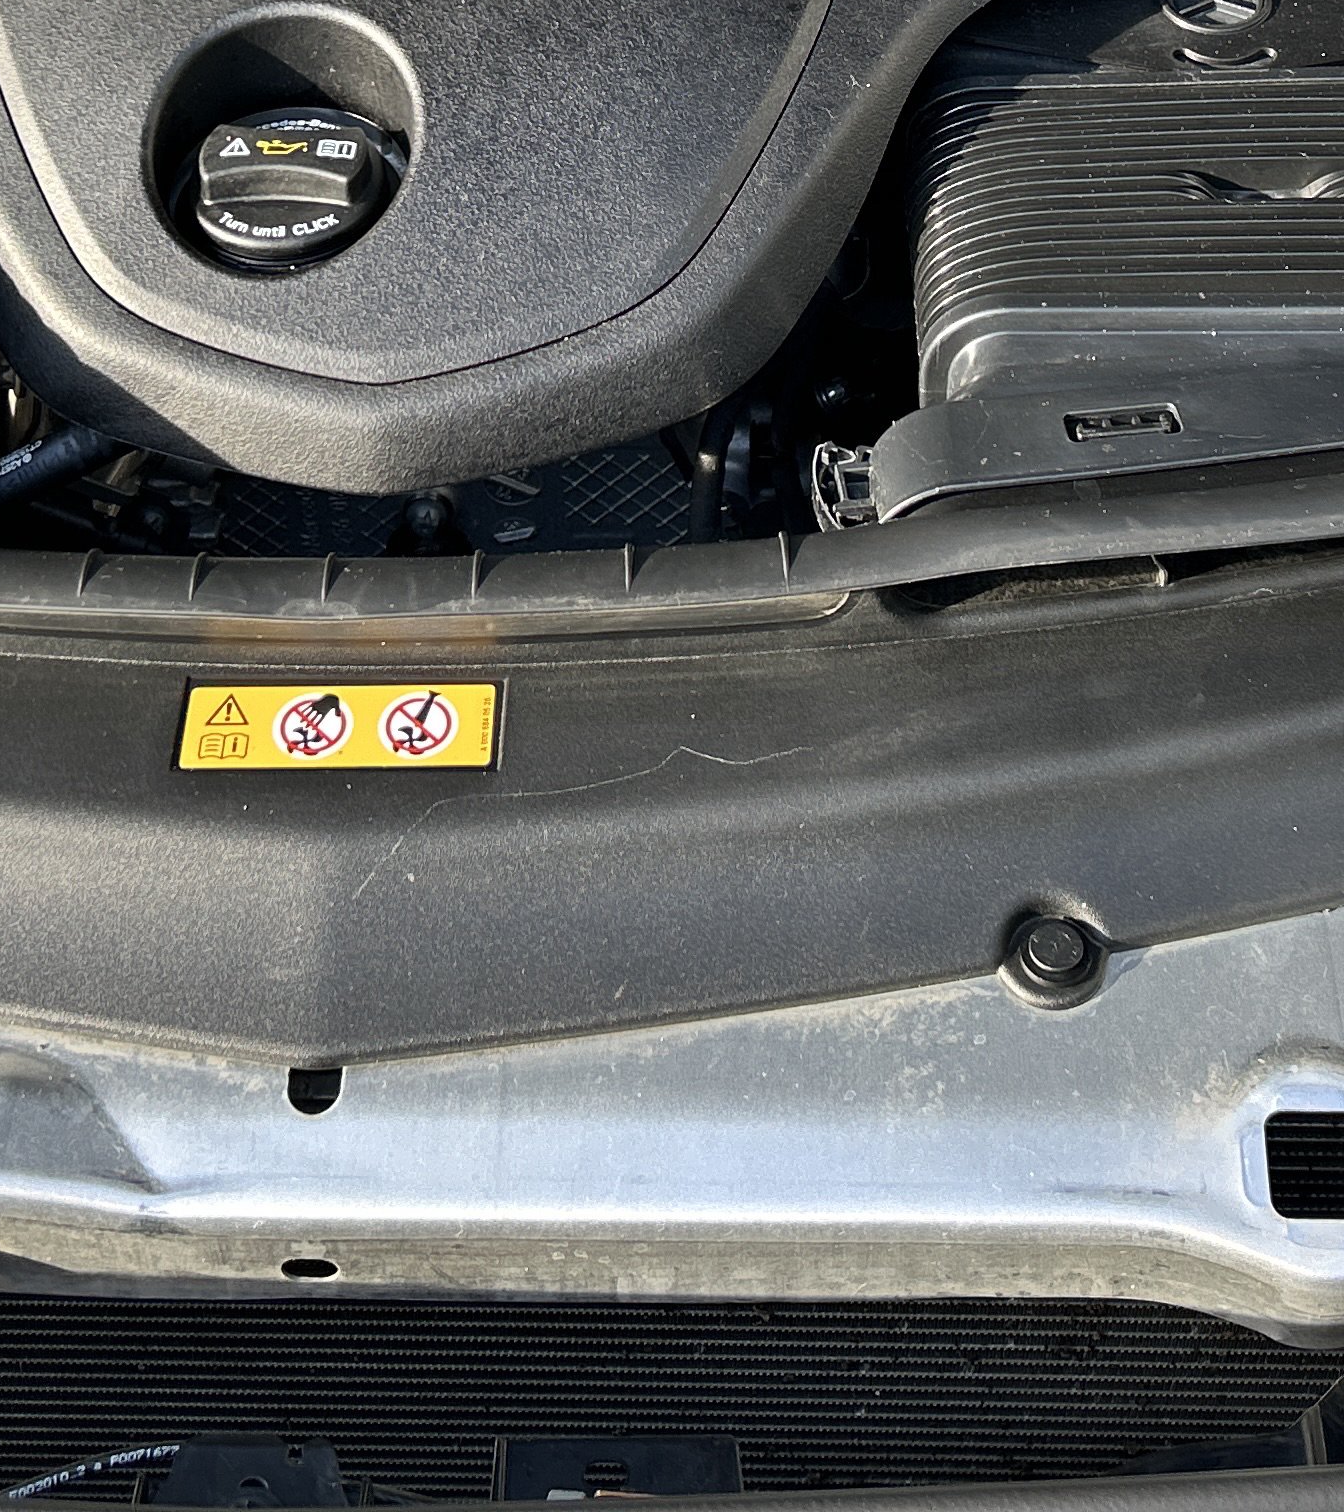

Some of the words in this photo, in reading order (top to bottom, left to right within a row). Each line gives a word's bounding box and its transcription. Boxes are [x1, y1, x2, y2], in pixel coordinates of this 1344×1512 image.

[218, 211, 249, 234] Turn
[252, 225, 286, 237] until
[292, 213, 340, 237] CLICK
